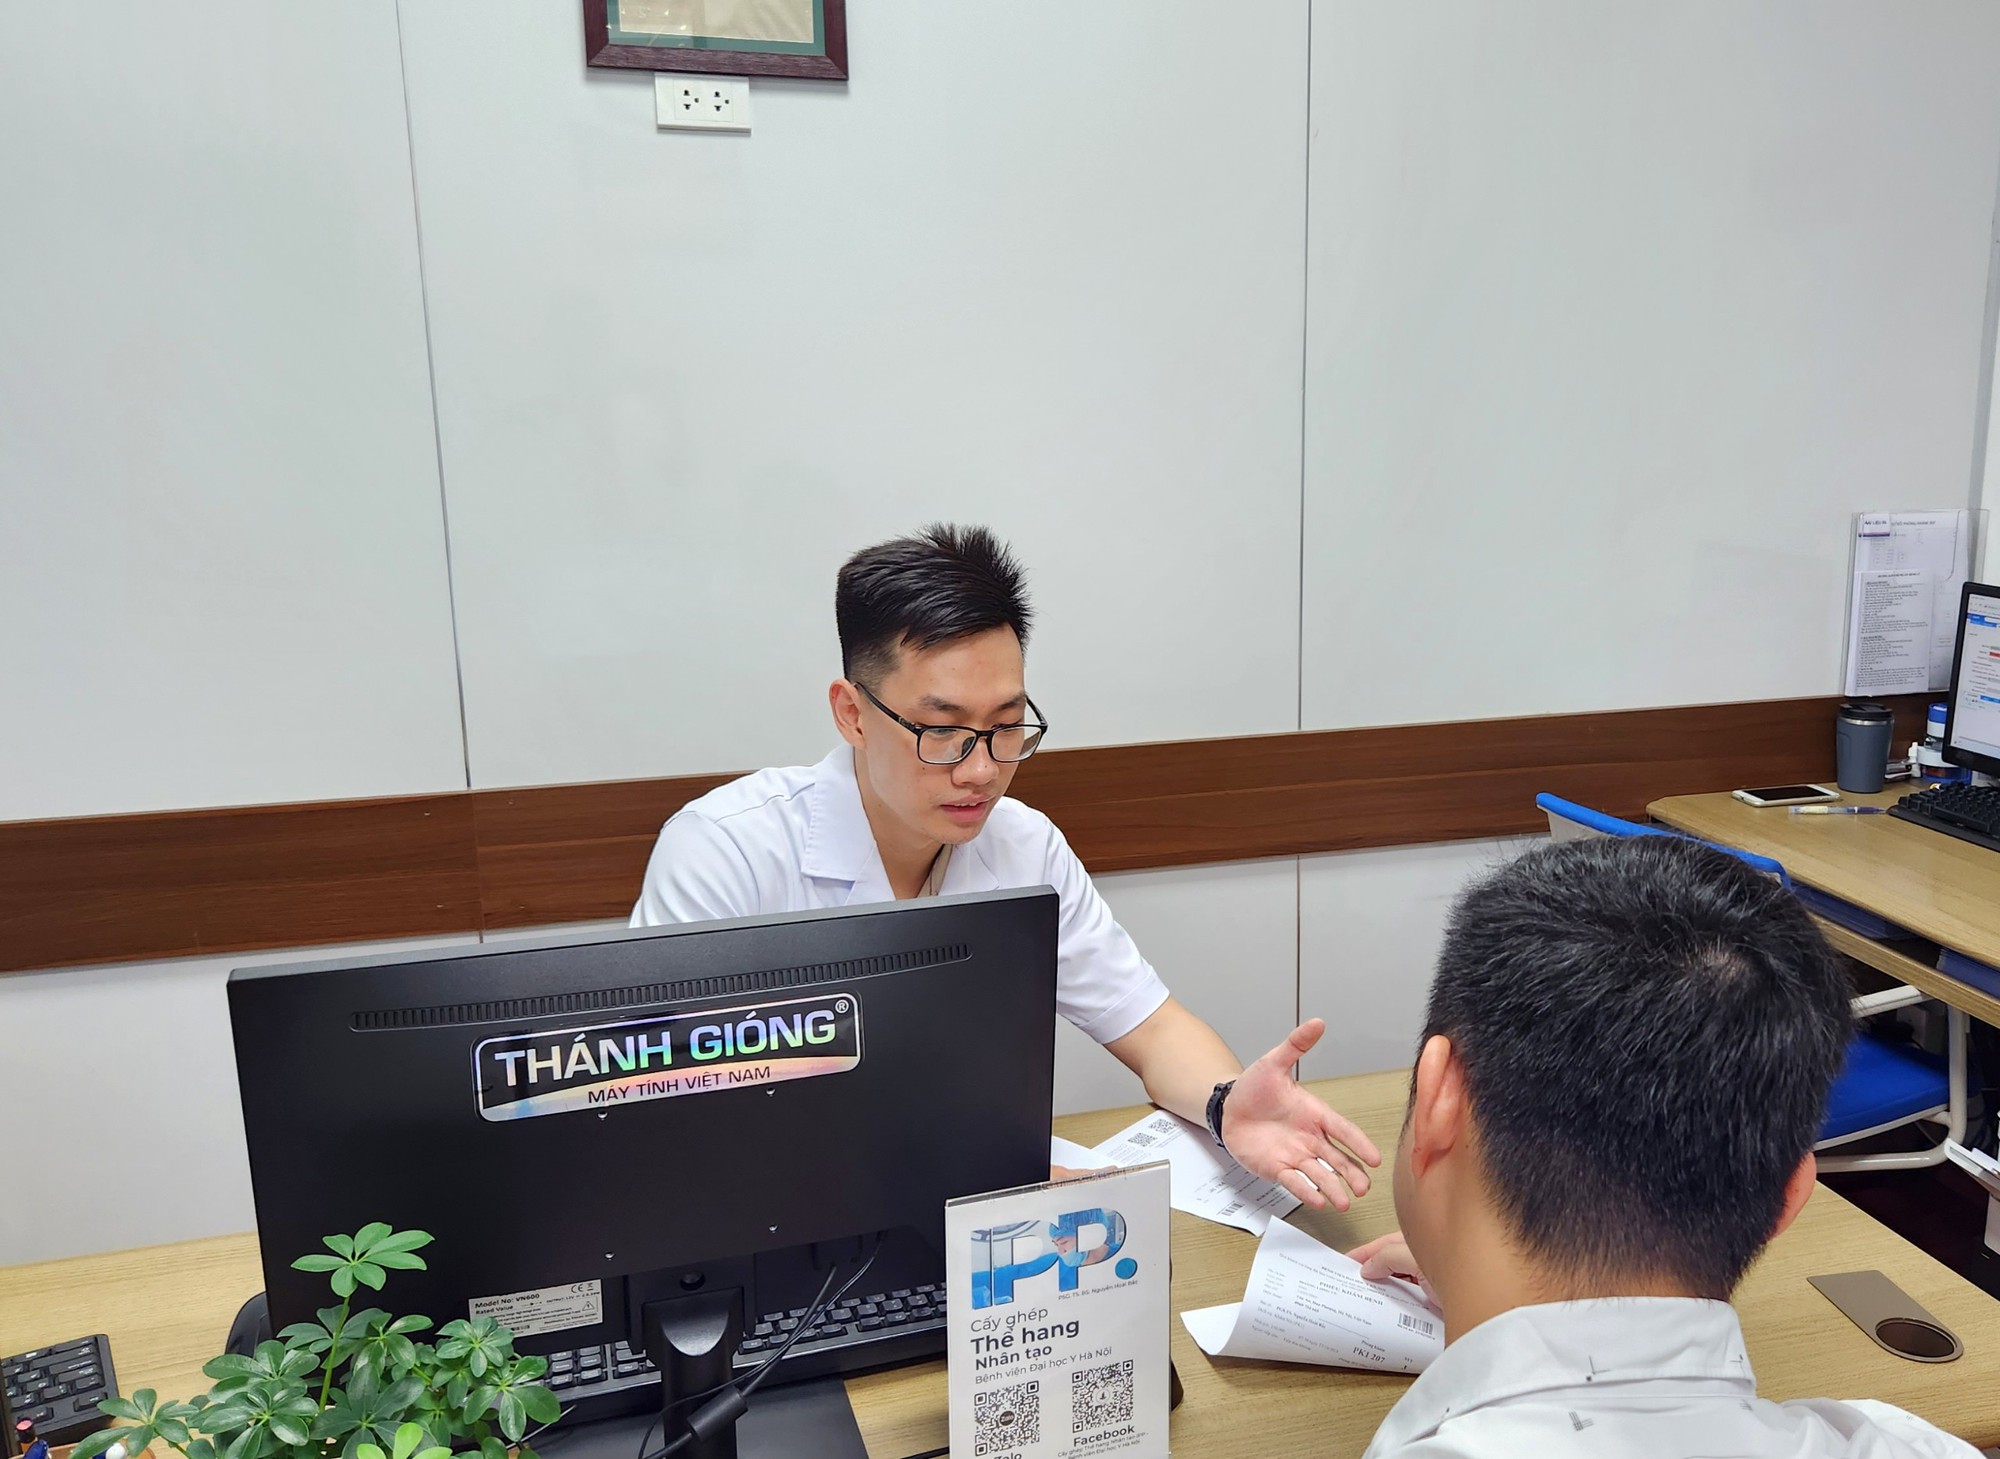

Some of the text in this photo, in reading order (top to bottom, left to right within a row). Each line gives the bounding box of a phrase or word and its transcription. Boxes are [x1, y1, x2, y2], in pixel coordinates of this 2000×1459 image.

[494, 1009, 836, 1087] THÁNH GIÓNG
[588, 1065, 771, 1104] MÁY TÍNH VIỆT NAM
[475, 1293, 540, 1309] Model No: VN600
[475, 1307, 495, 1315] Rated
[496, 1305, 514, 1313] Value
[970, 1307, 1049, 1333] Cấy ghép
[970, 1320, 1080, 1355] Thể hang
[975, 1345, 1053, 1371] Nhân tạo
[975, 1346, 1112, 1385] Bệnh viện Đại học Y Hà Nội
[1370, 1352, 1386, 1364] 207
[1073, 1424, 1135, 1447] Facebook
